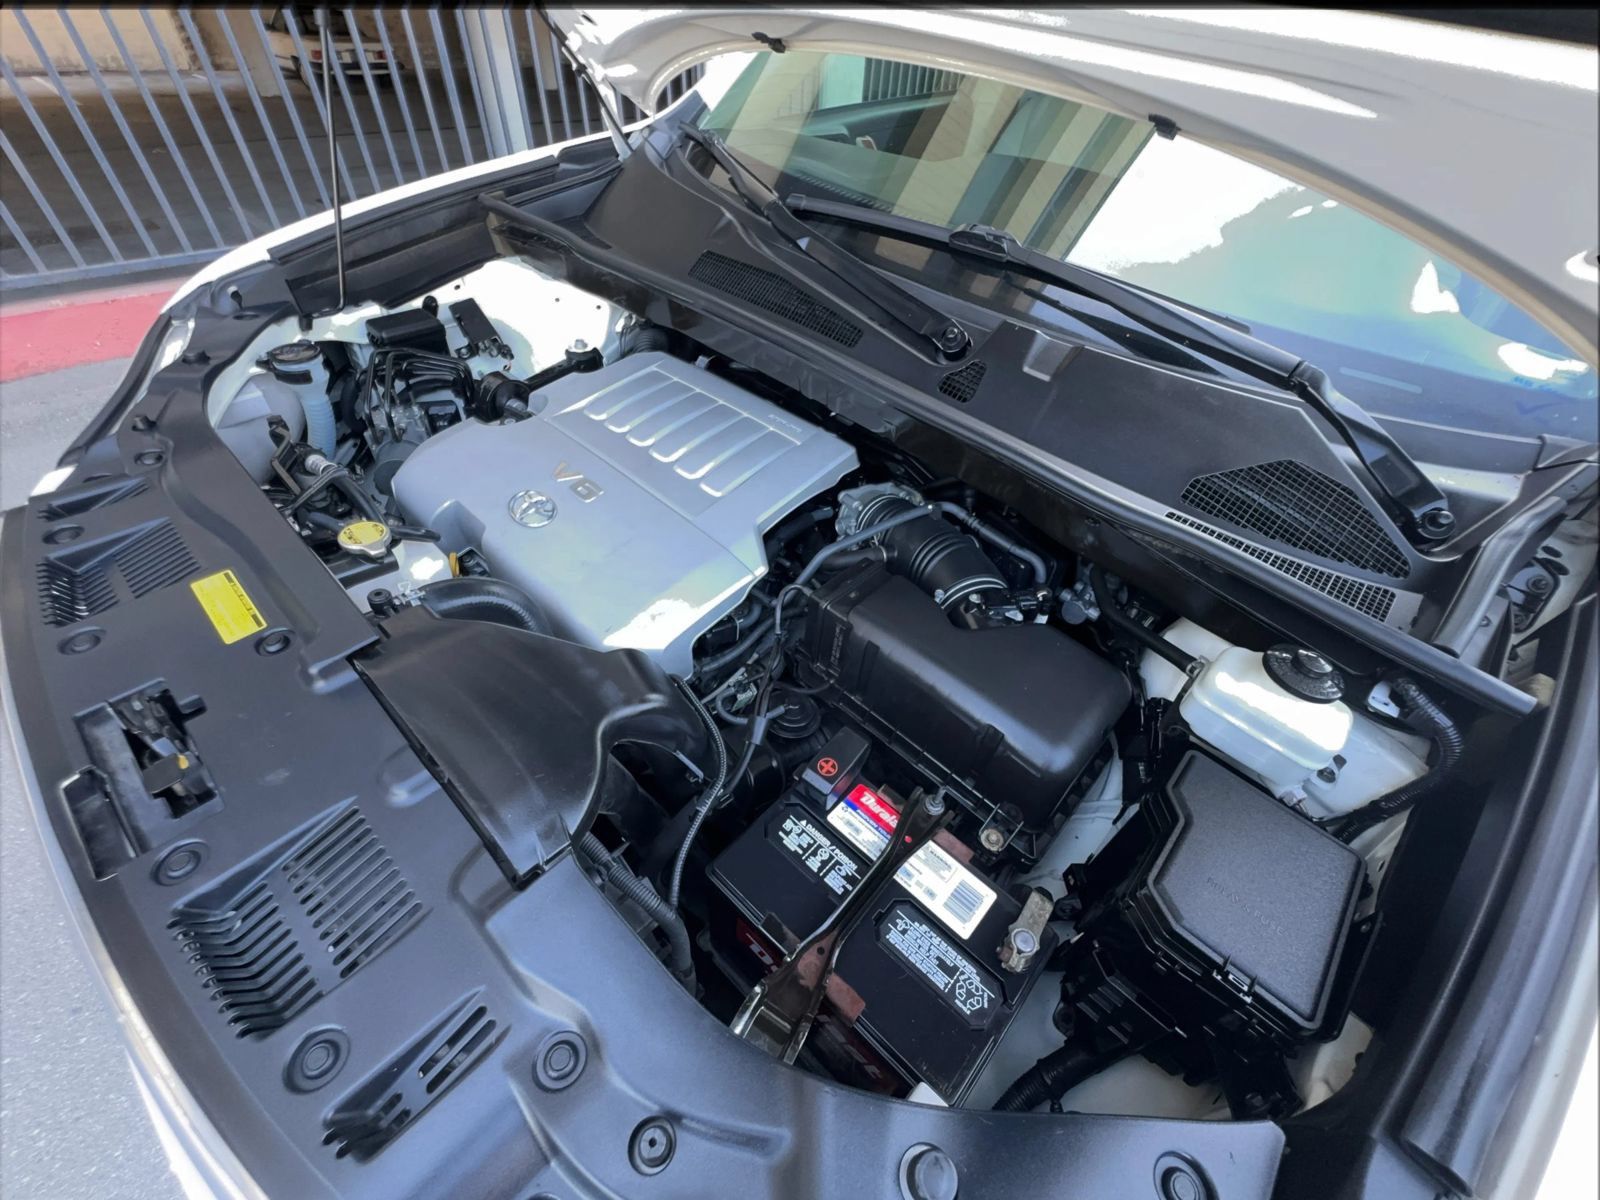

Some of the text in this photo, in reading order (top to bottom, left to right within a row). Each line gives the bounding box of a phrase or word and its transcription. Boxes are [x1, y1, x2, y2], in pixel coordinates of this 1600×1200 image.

[552, 461, 605, 503] V6
[858, 791, 901, 828] Durala
[805, 823, 831, 847] DANGER
[833, 848, 857, 870] POISON
[1254, 910, 1288, 936] FUSE
